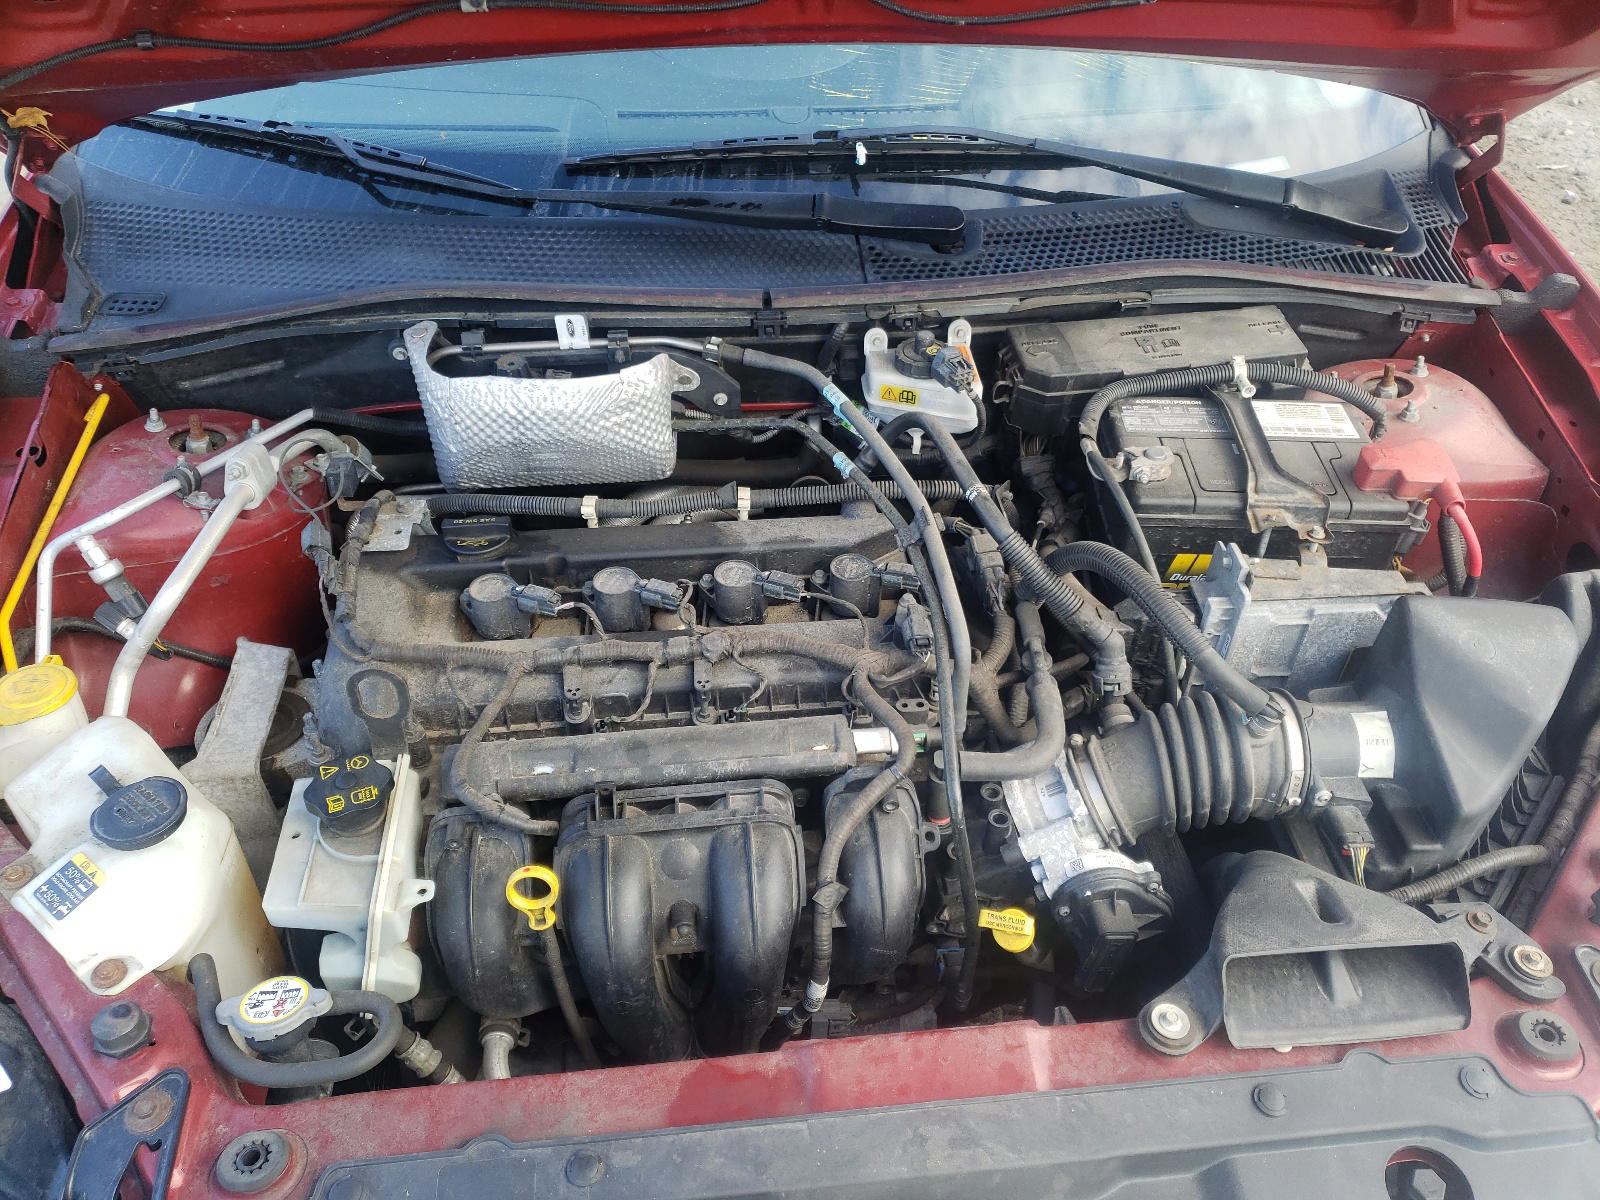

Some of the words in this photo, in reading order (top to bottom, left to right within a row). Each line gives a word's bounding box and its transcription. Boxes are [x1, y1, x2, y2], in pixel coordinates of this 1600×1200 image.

[65, 866, 83, 884] 50%
[987, 912, 1007, 922] TRANS
[1008, 916, 1026, 926] FLUID
